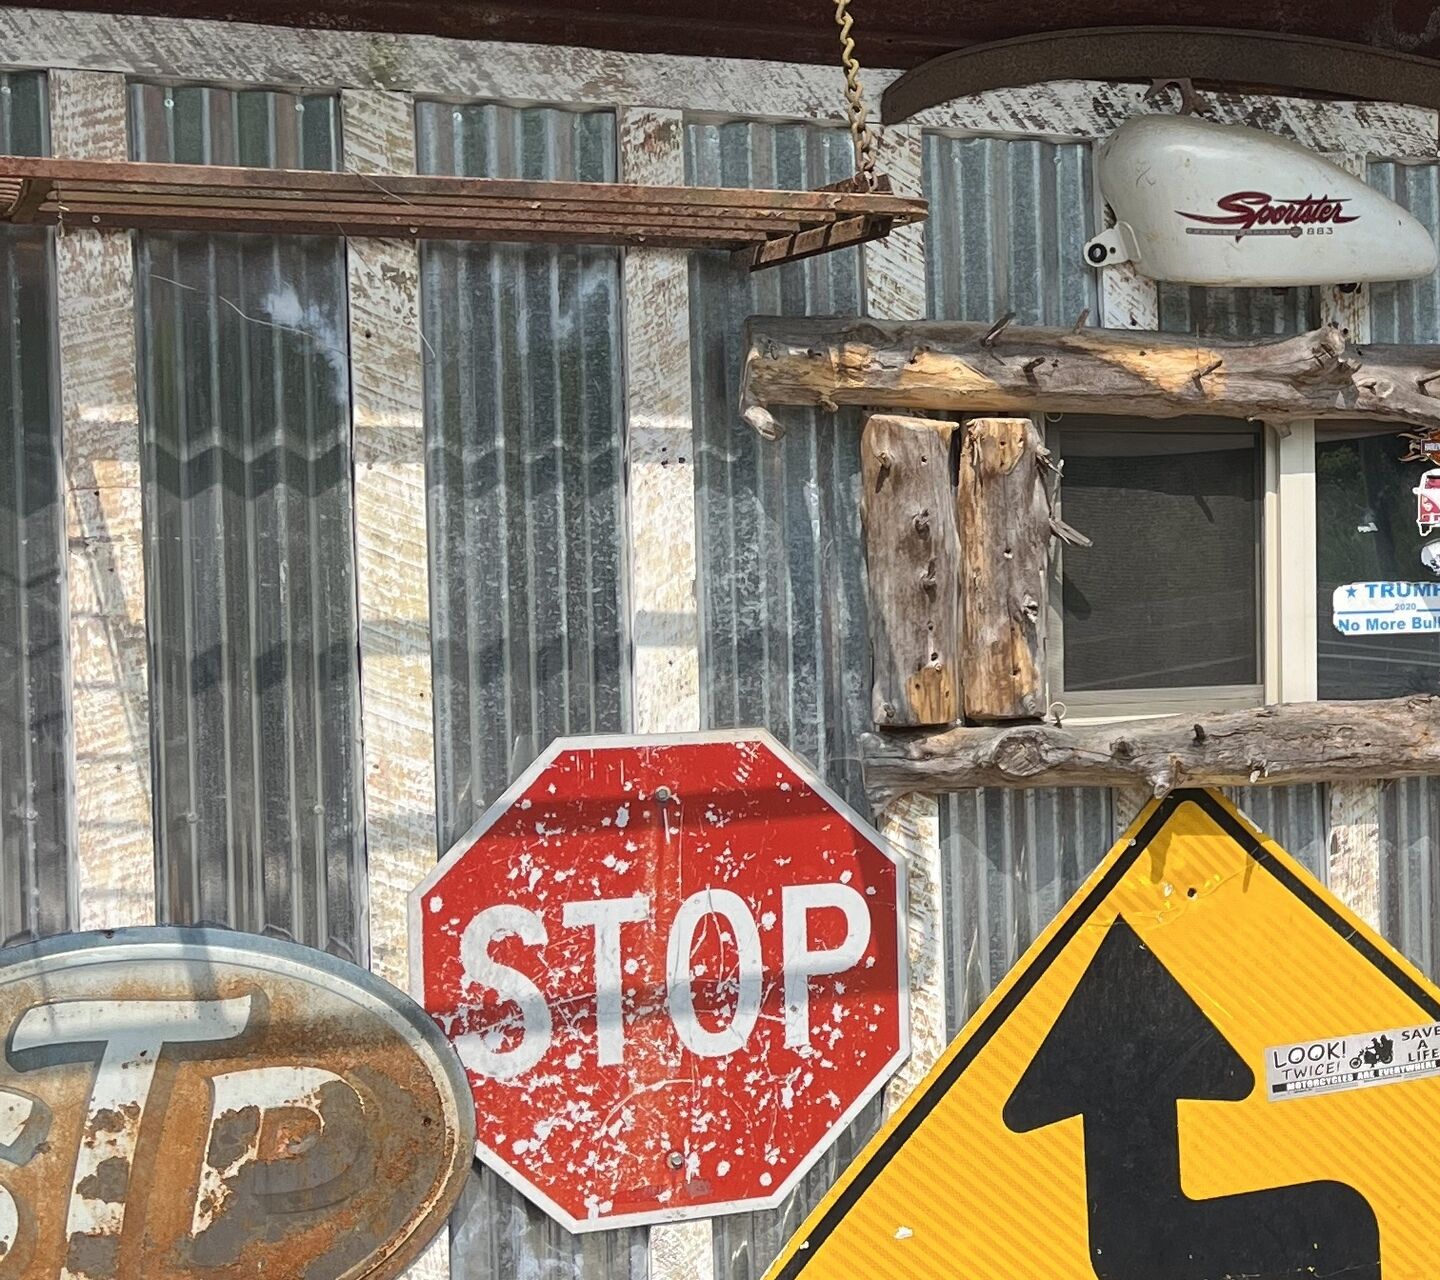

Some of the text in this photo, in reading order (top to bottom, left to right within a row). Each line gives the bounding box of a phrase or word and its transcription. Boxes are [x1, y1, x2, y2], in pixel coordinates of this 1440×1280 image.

[1175, 191, 1361, 243] Sportster
[1306, 227, 1334, 235] 883
[1394, 602, 1417, 611] 2020
[1338, 619, 1360, 632] No
[1366, 618, 1407, 631] More
[455, 883, 872, 1081] STOP
[1417, 1039, 1428, 1049] A
[1273, 1040, 1347, 1069] LOOK!
[1408, 1048, 1440, 1063] LIFE
[1282, 1061, 1341, 1080] TWICE!
[1286, 1073, 1354, 1091] MOTORCYCLES
[1357, 1069, 1375, 1080] ARE
[1378, 1060, 1437, 1078] EVERYWHERE
